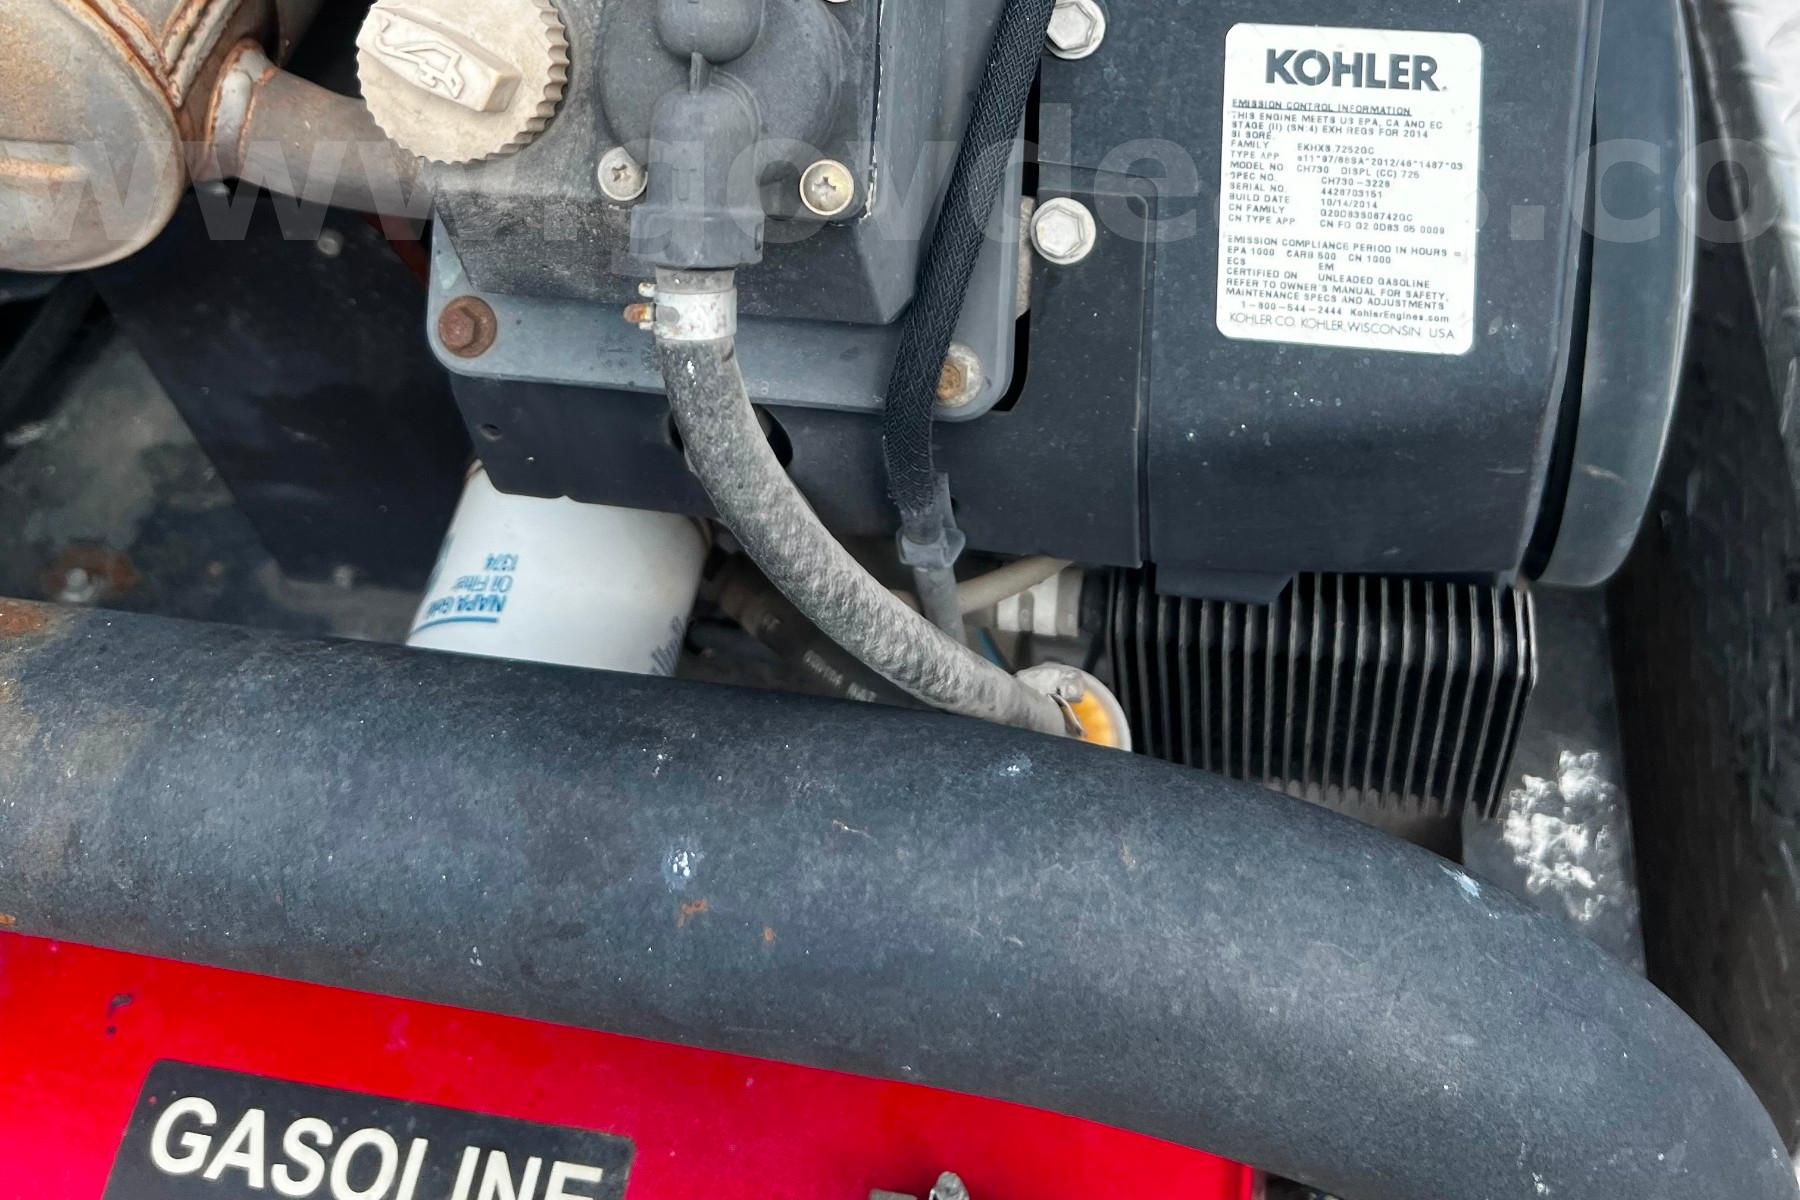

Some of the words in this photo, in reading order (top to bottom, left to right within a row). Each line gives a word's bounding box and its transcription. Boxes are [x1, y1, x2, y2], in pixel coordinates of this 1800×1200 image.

[1265, 48, 1441, 92] KOHLER
[1231, 99, 1284, 109] EMISSION
[1285, 101, 1336, 112] CONTROL
[1336, 103, 1413, 115] INFORMATION
[1231, 111, 1255, 120] THIS
[1259, 112, 1297, 122] ENGINE
[1301, 114, 1336, 124] MEETS
[1339, 116, 1354, 124] US
[1385, 118, 1400, 126] CA
[1403, 118, 1425, 128] AND
[1429, 119, 1443, 128] EC
[1231, 120, 1264, 130] STAGE
[1322, 124, 1343, 133] EXH
[1346, 125, 1374, 135] REGS
[1378, 127, 1399, 136] FOR
[1403, 128, 1428, 137] 2014
[1231, 130, 1241, 138] SI
[1230, 139, 1269, 149] FAMILY
[1230, 150, 1255, 159] TYPE
[1260, 152, 1280, 160] APP
[1229, 161, 1265, 170] MODEL
[1296, 164, 1329, 173] CH730
[1229, 171, 1256, 180] SPEC
[1340, 167, 1371, 176] DISPL
[1376, 168, 1397, 178] (CC)
[1401, 170, 1420, 179] 725
[1229, 182, 1265, 191] SERIAL
[1228, 192, 1260, 202] BUILD
[1263, 194, 1289, 203] DATE
[1320, 198, 1378, 208] 10/14/2014
[1228, 203, 1242, 211] CN
[1246, 204, 1285, 214] FAMILY
[1228, 213, 1242, 222] CN
[1246, 214, 1271, 224] TYPE
[1275, 216, 1296, 225] APP
[1319, 219, 1334, 228] CN
[1227, 235, 1278, 246] EMISSION
[1281, 238, 1349, 250] COMPLIANCE
[1352, 242, 1392, 253] PERIOD
[1395, 245, 1407, 253] IN
[1411, 246, 1448, 256] HOURS
[1227, 245, 1247, 254] EPA
[1251, 247, 1275, 256] 1000
[1286, 249, 1314, 259] CARB
[1348, 253, 1362, 262] CN
[1366, 254, 1391, 264] 1000
[1226, 256, 1246, 265] ECS
[1318, 262, 1334, 271] EM
[1226, 267, 1280, 278] CERTIFIED
[1283, 270, 1298, 279] ON
[1317, 273, 1374, 284] UNLEADED
[1377, 276, 1430, 288] GASOLINE
[1226, 277, 1259, 287] REFER
[1262, 280, 1276, 289] TO
[1279, 281, 1328, 292] OWNER'S
[1332, 284, 1376, 295] MANUAL
[1380, 287, 1401, 297] FOR
[1225, 287, 1299, 300] MAINTENANCE
[1303, 292, 1337, 302] SPECS
[1341, 295, 1363, 304] AND
[1367, 296, 1444, 309] ADJUSTMENTS
[1229, 311, 1273, 326] KOHLER
[1347, 319, 1421, 336] WISCONSIN
[1429, 325, 1455, 339] USA
[457, 594, 507, 614] NAPA
